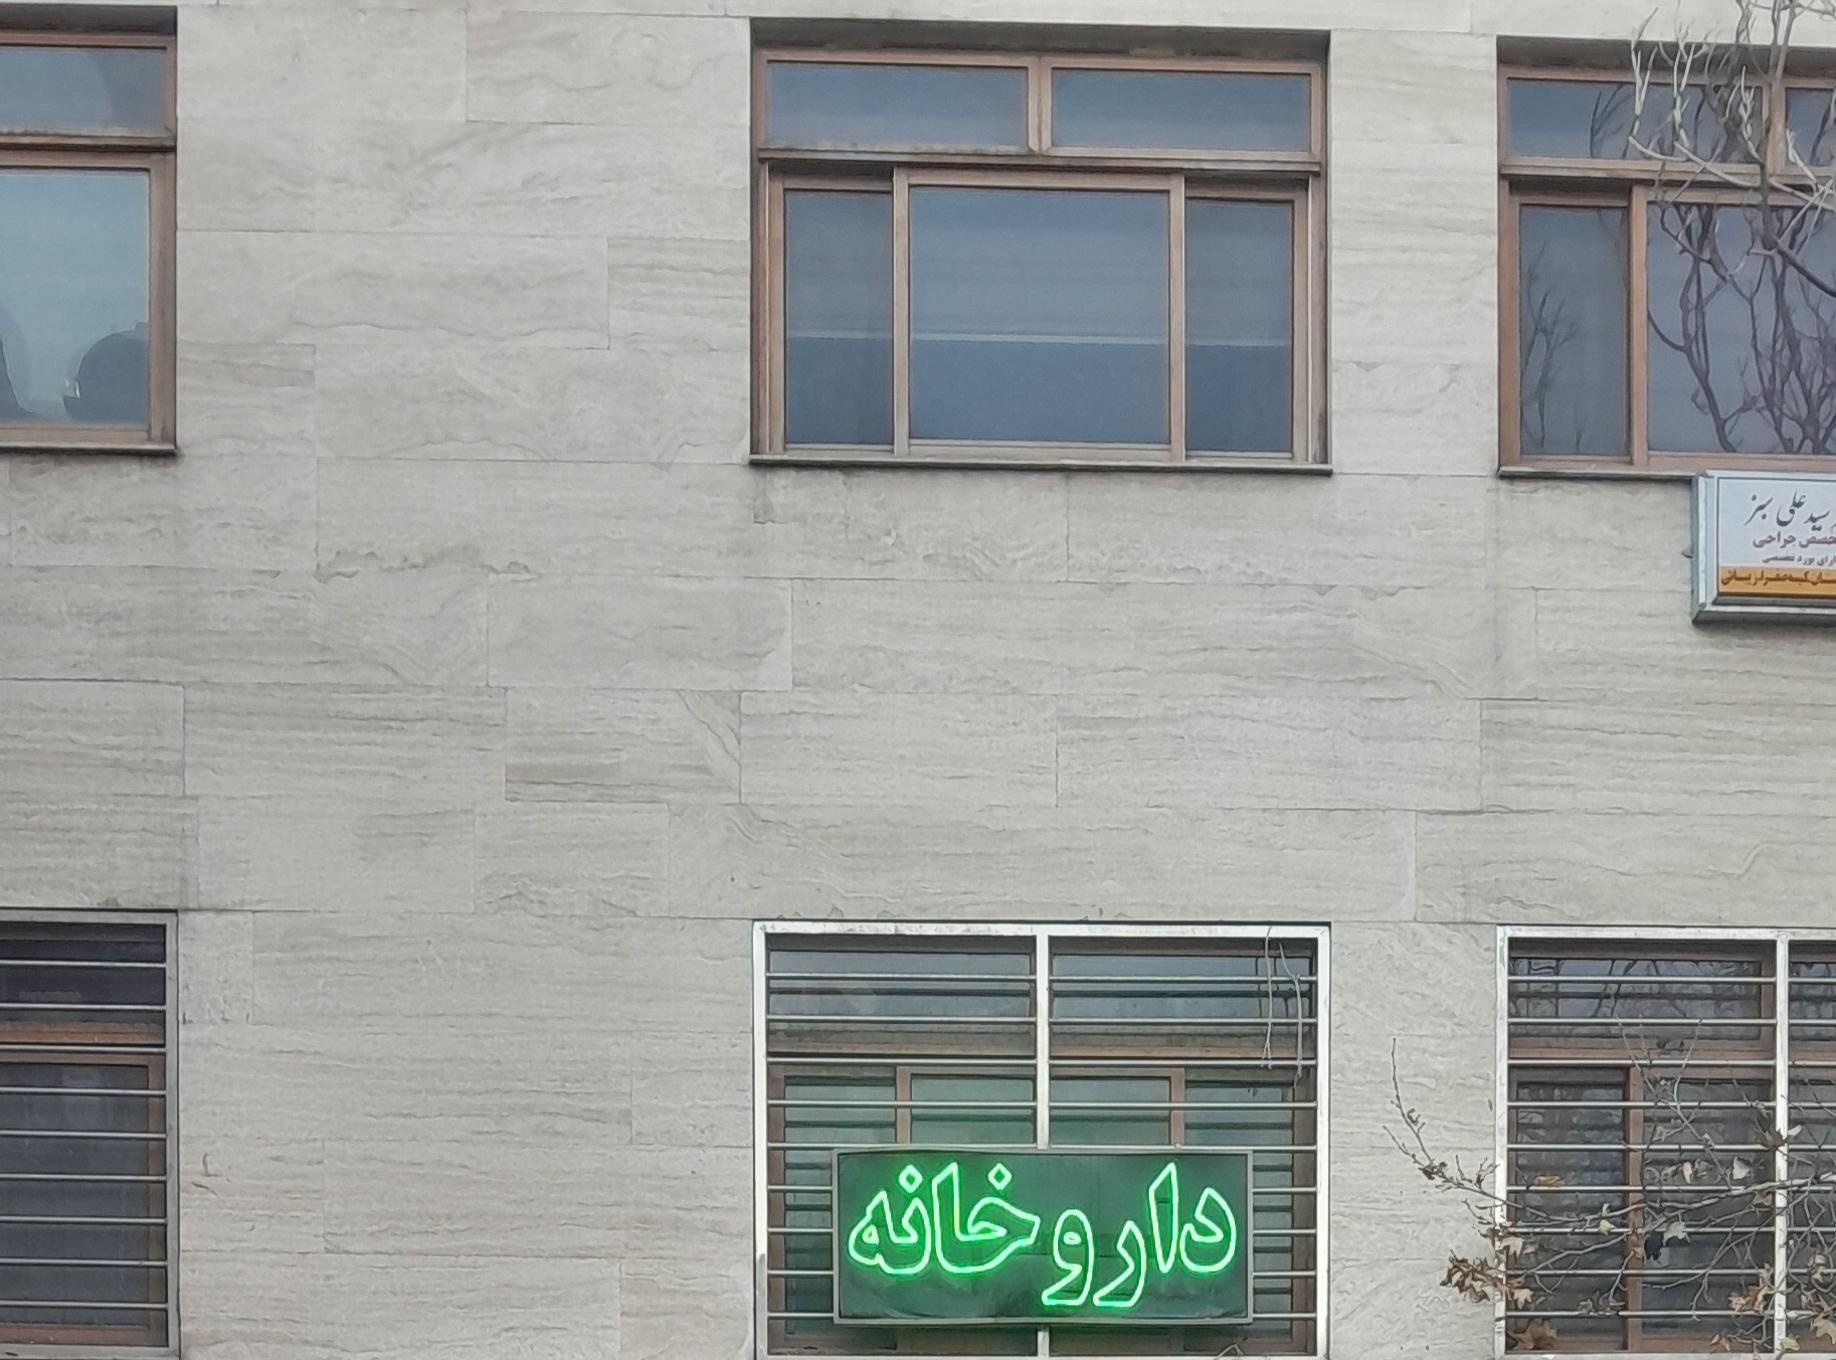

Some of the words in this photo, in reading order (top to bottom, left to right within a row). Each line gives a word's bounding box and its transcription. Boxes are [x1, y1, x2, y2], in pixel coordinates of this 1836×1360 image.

[1776, 490, 1807, 527] علی
[1803, 509, 1831, 532] سید
[1752, 531, 1797, 549] جراحی
[1816, 553, 1836, 567] ارای
[847, 1161, 1238, 1308] داروخانه
